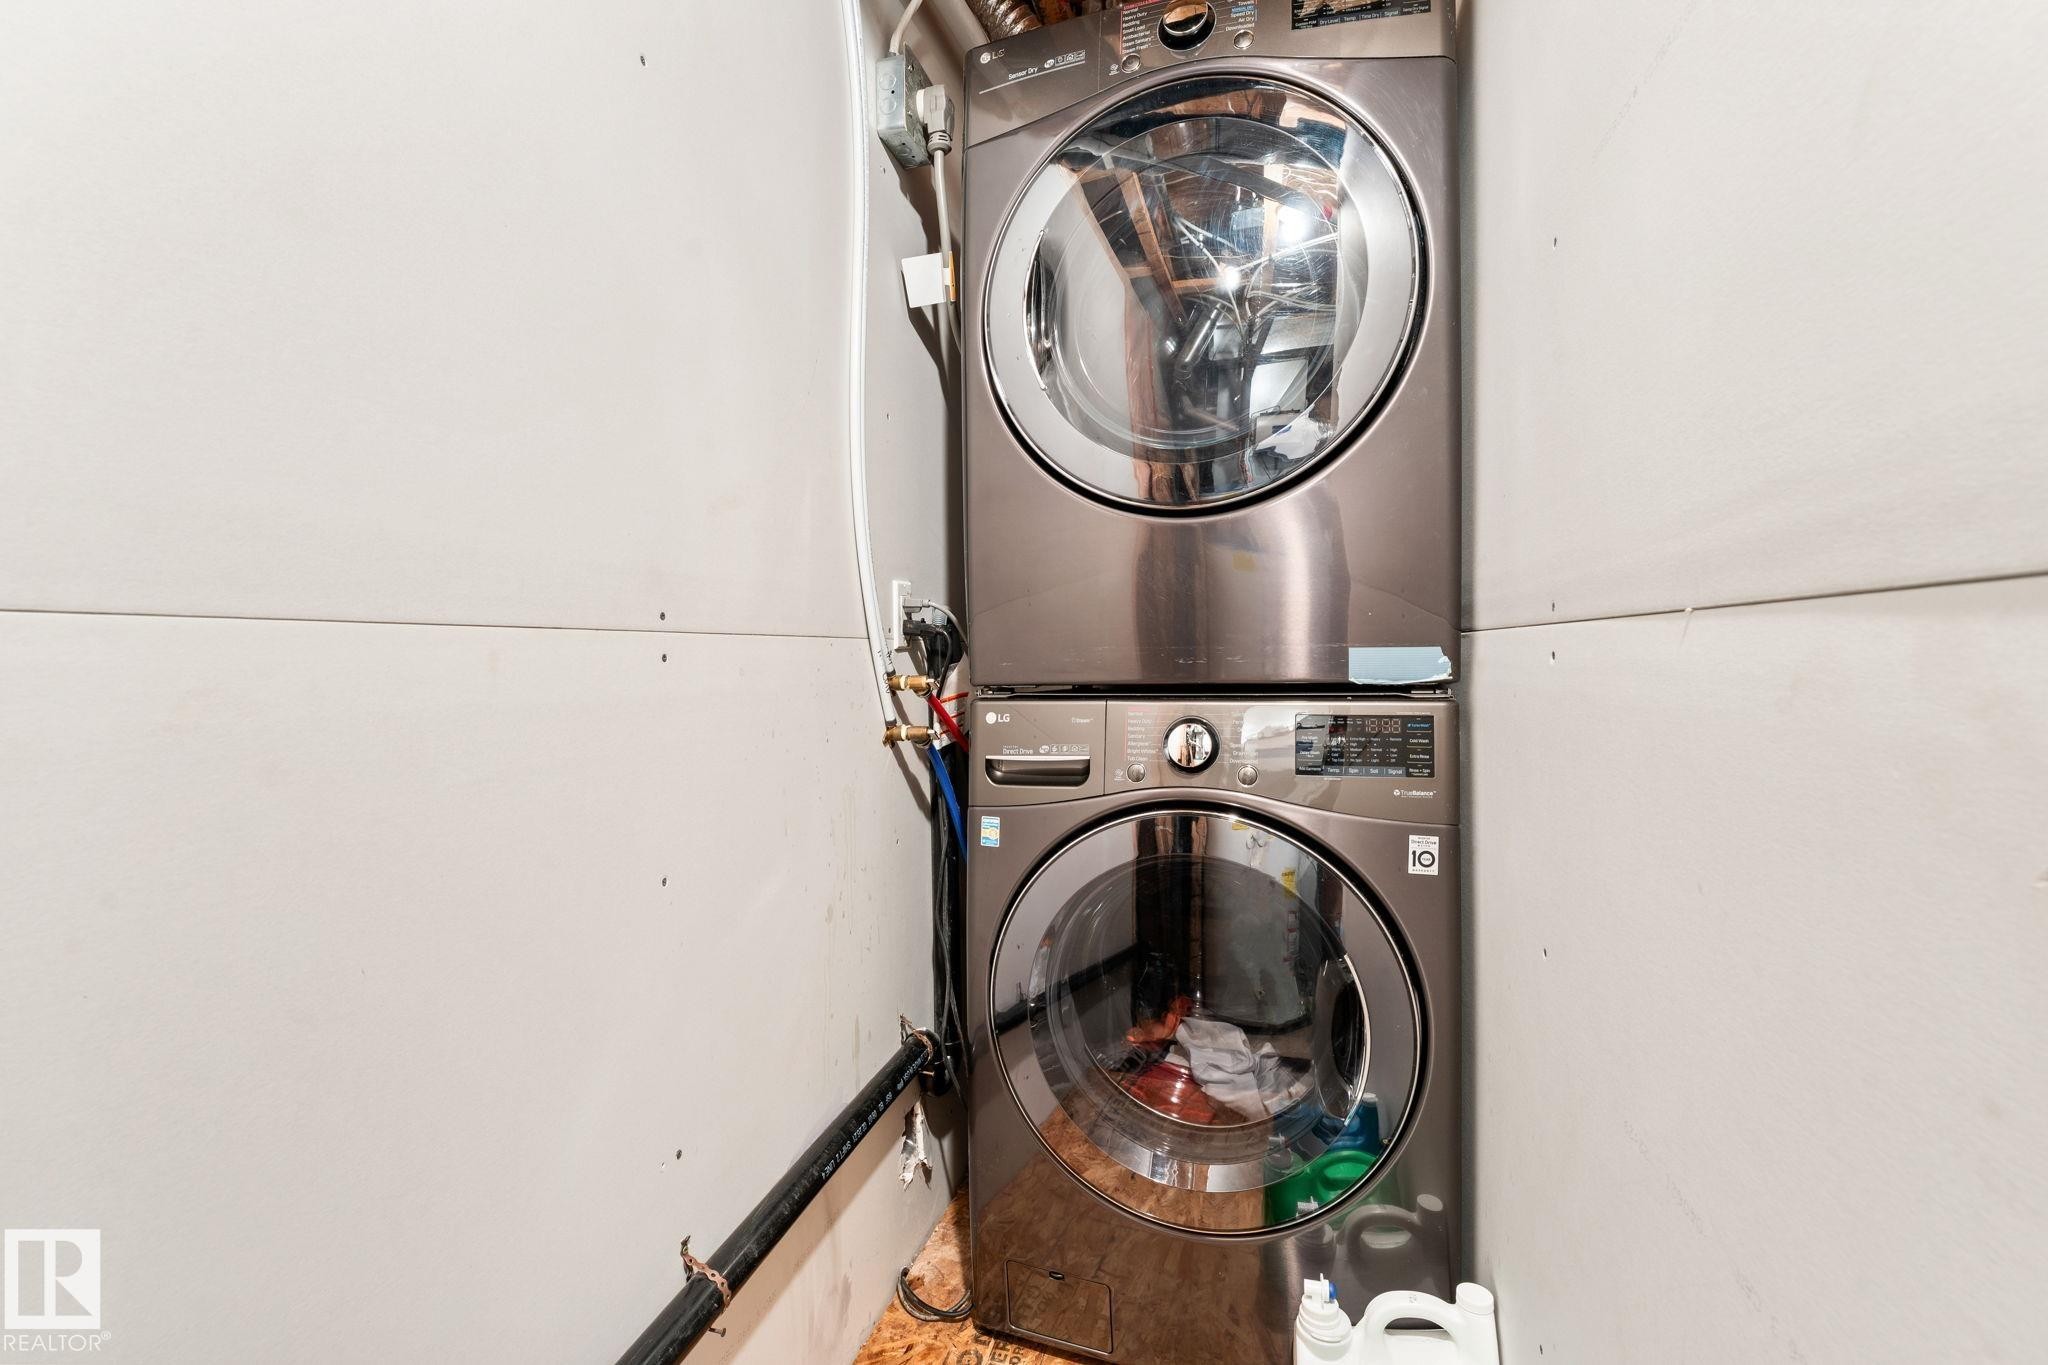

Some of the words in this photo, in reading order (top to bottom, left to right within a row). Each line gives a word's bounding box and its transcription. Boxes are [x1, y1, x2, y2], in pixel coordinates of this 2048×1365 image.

[1008, 70, 1028, 80] Sensor
[1027, 66, 1039, 75] Dry
[1411, 850, 1436, 868] 10
